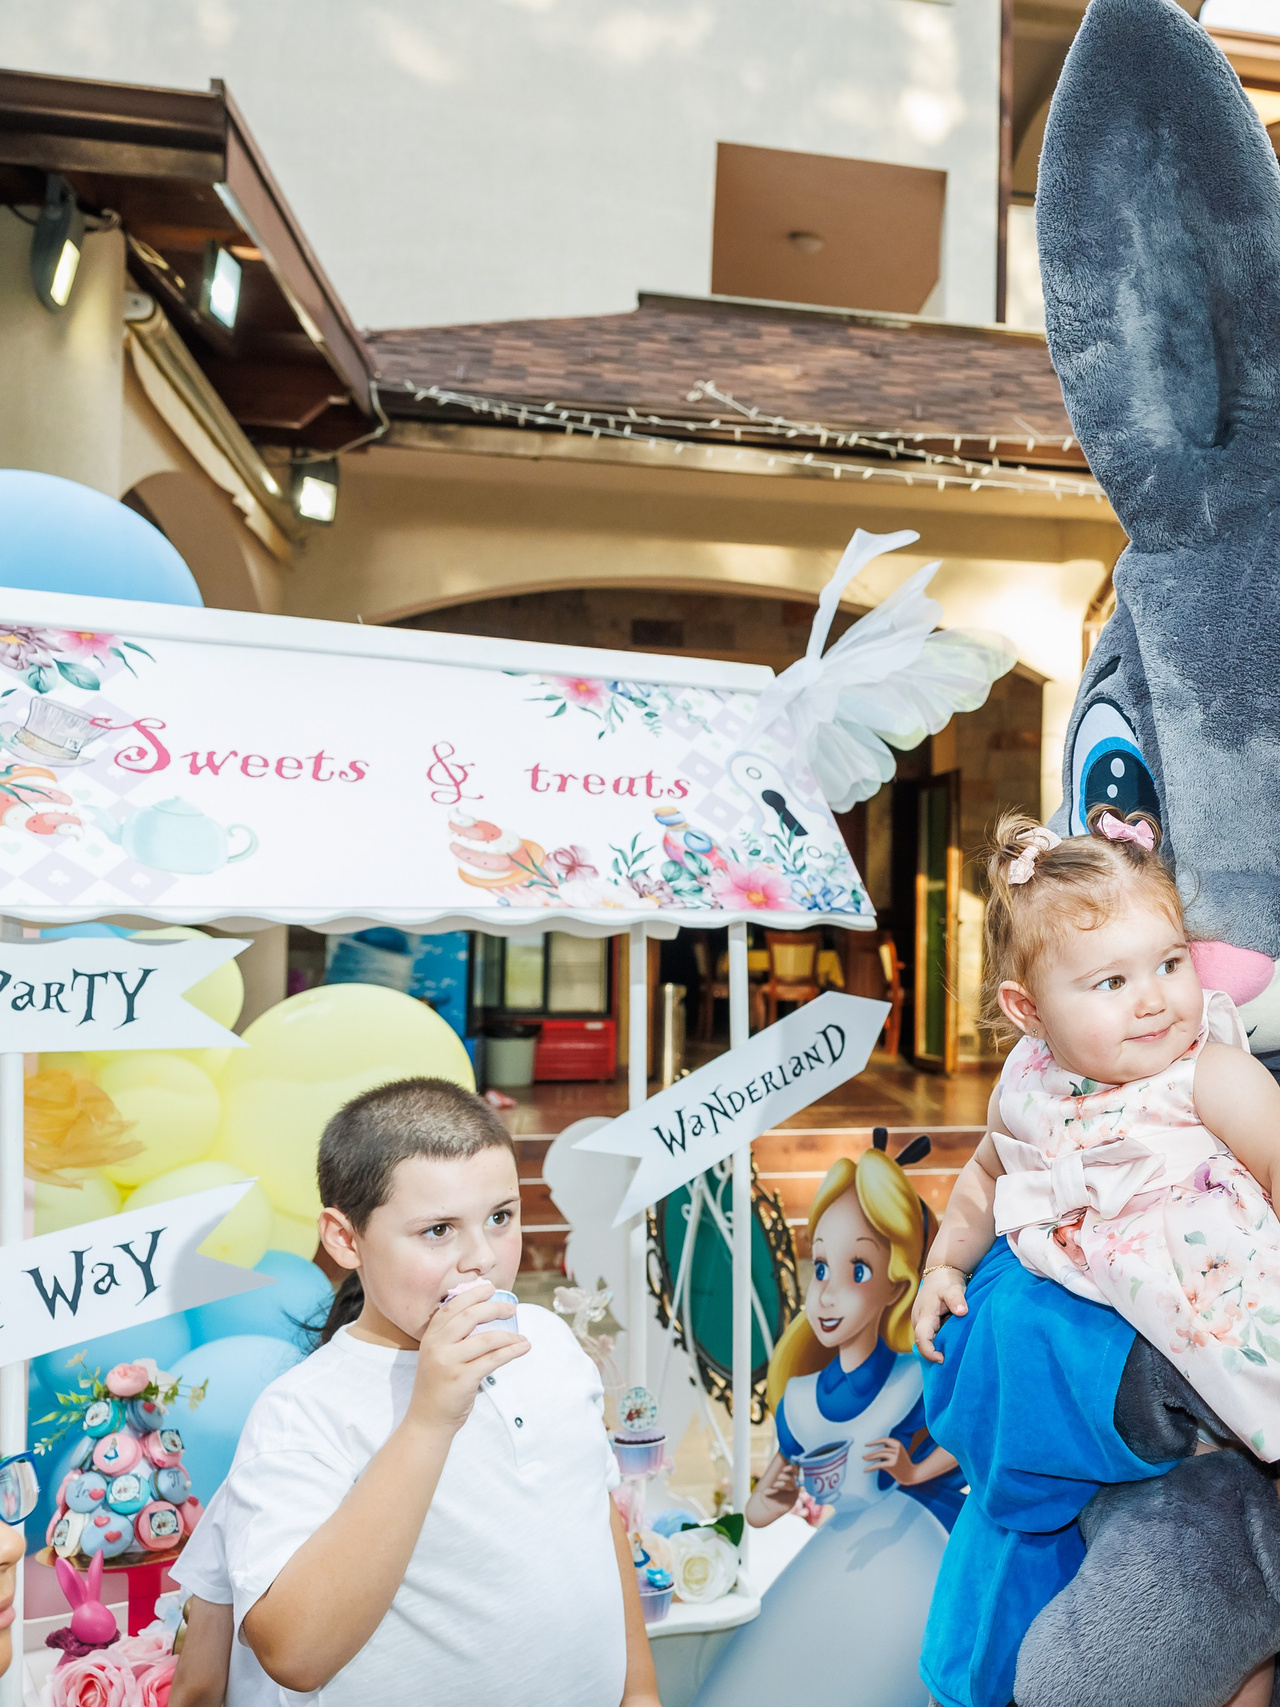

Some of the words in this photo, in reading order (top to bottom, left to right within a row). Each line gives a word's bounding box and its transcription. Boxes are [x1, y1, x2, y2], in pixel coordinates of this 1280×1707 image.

[89, 717, 370, 783] Sweets
[427, 741, 484, 805] &
[524, 762, 691, 799] treats
